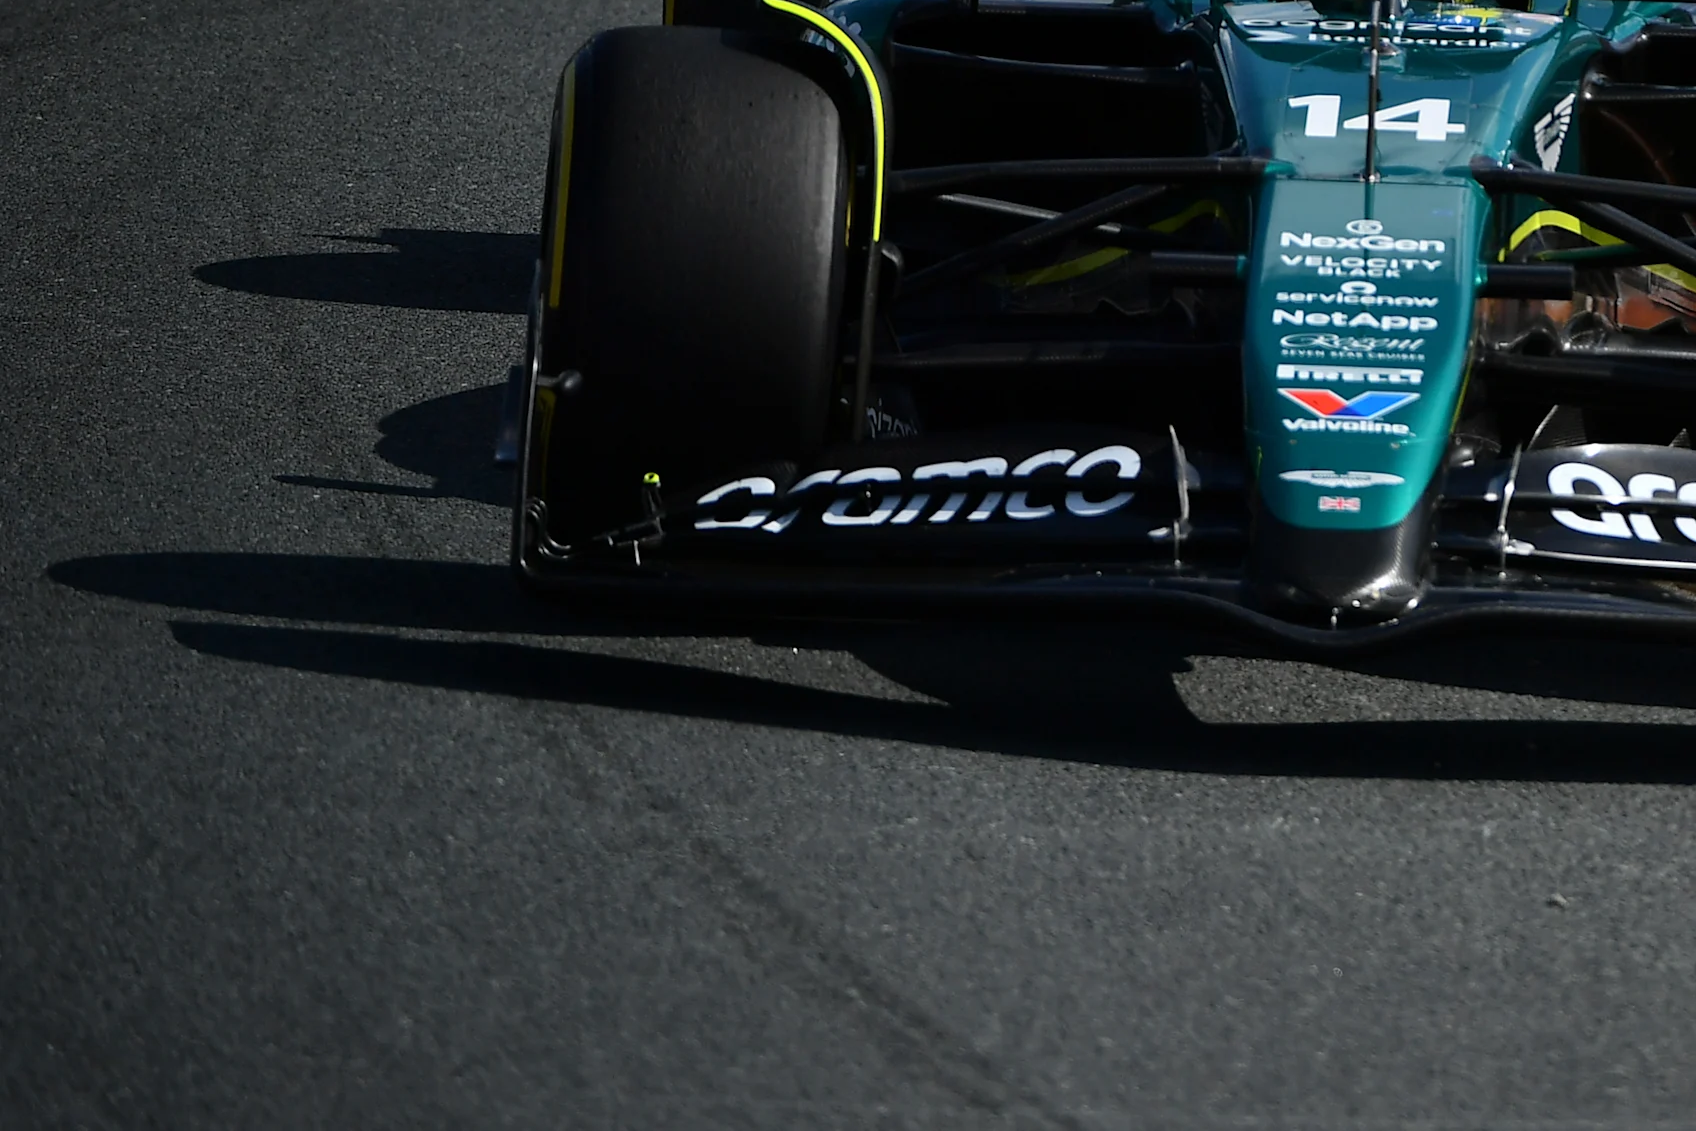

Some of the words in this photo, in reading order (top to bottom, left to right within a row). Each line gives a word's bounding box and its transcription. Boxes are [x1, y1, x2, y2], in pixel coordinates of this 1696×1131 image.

[1288, 94, 1466, 141] 14
[1280, 231, 1446, 253] NexGen
[1280, 254, 1442, 271] VELOCITY
[1317, 266, 1401, 278] BLACK
[1276, 292, 1439, 308] servicenow
[1272, 309, 1438, 333] NetApp
[1276, 363, 1424, 385] PIRELLI
[1282, 417, 1410, 435] Valvoline
[695, 445, 1142, 533] aramco
